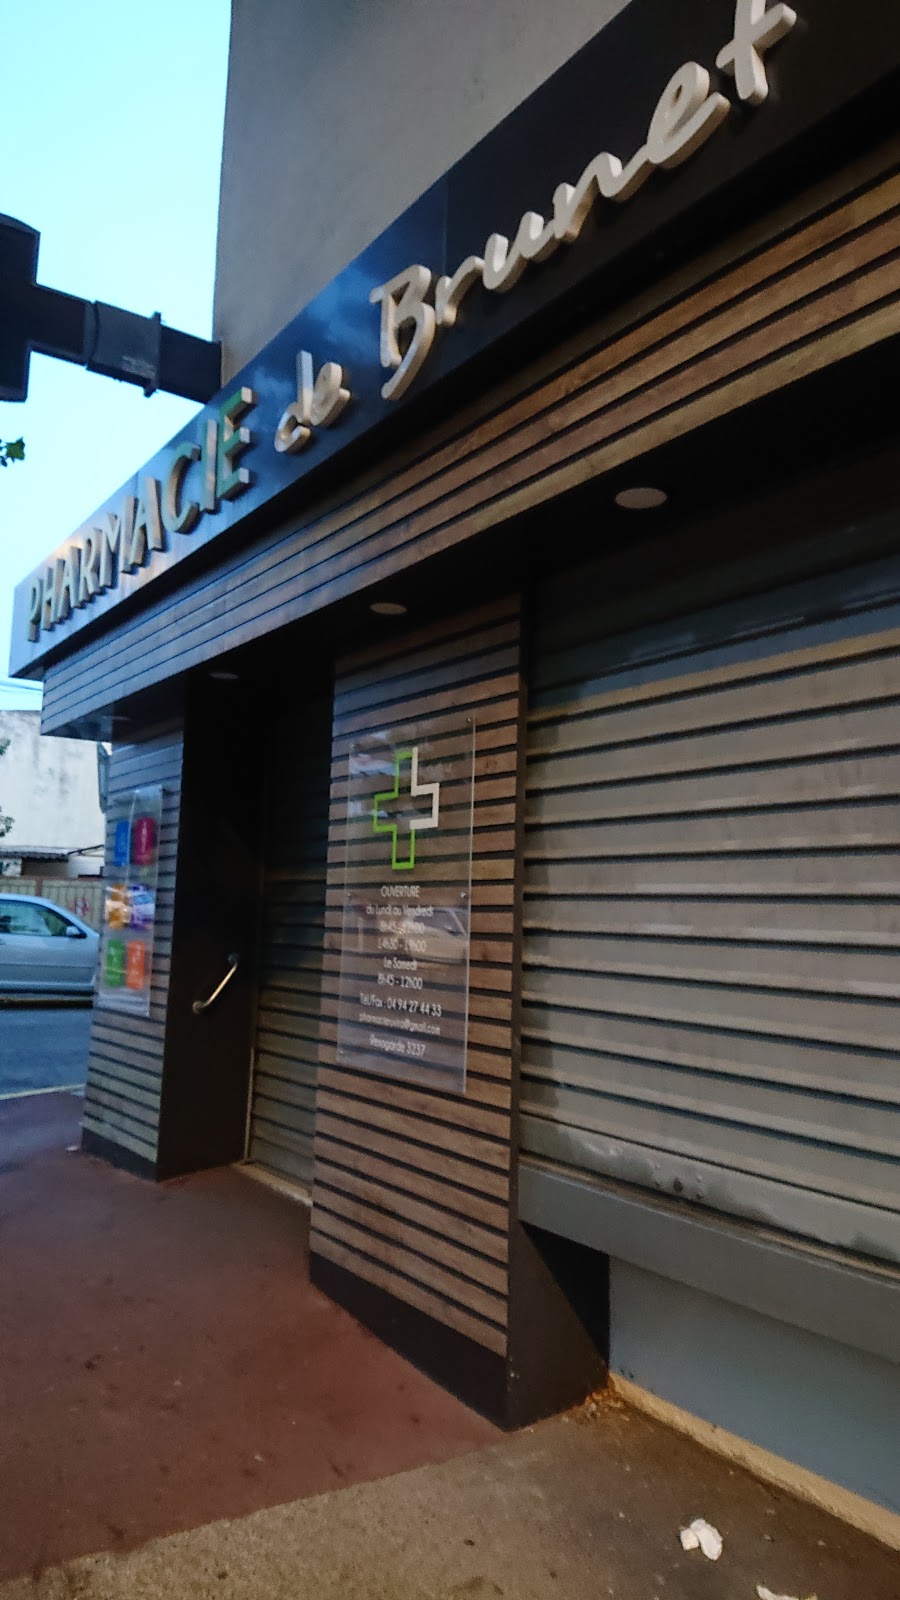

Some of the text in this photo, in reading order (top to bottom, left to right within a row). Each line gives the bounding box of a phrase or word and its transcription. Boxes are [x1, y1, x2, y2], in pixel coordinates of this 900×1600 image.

[27, 0, 797, 643] PHARMACIE de Brunet
[381, 885, 420, 898] OUVERTURE
[393, 958, 418, 971] Samedi
[401, 976, 423, 990] 12h00
[387, 997, 396, 1010] 04
[397, 998, 408, 1012] 94
[408, 1000, 419, 1013] 27
[420, 1002, 430, 1015] 44
[431, 1004, 442, 1017] 33
[406, 1041, 426, 1057] 3237
